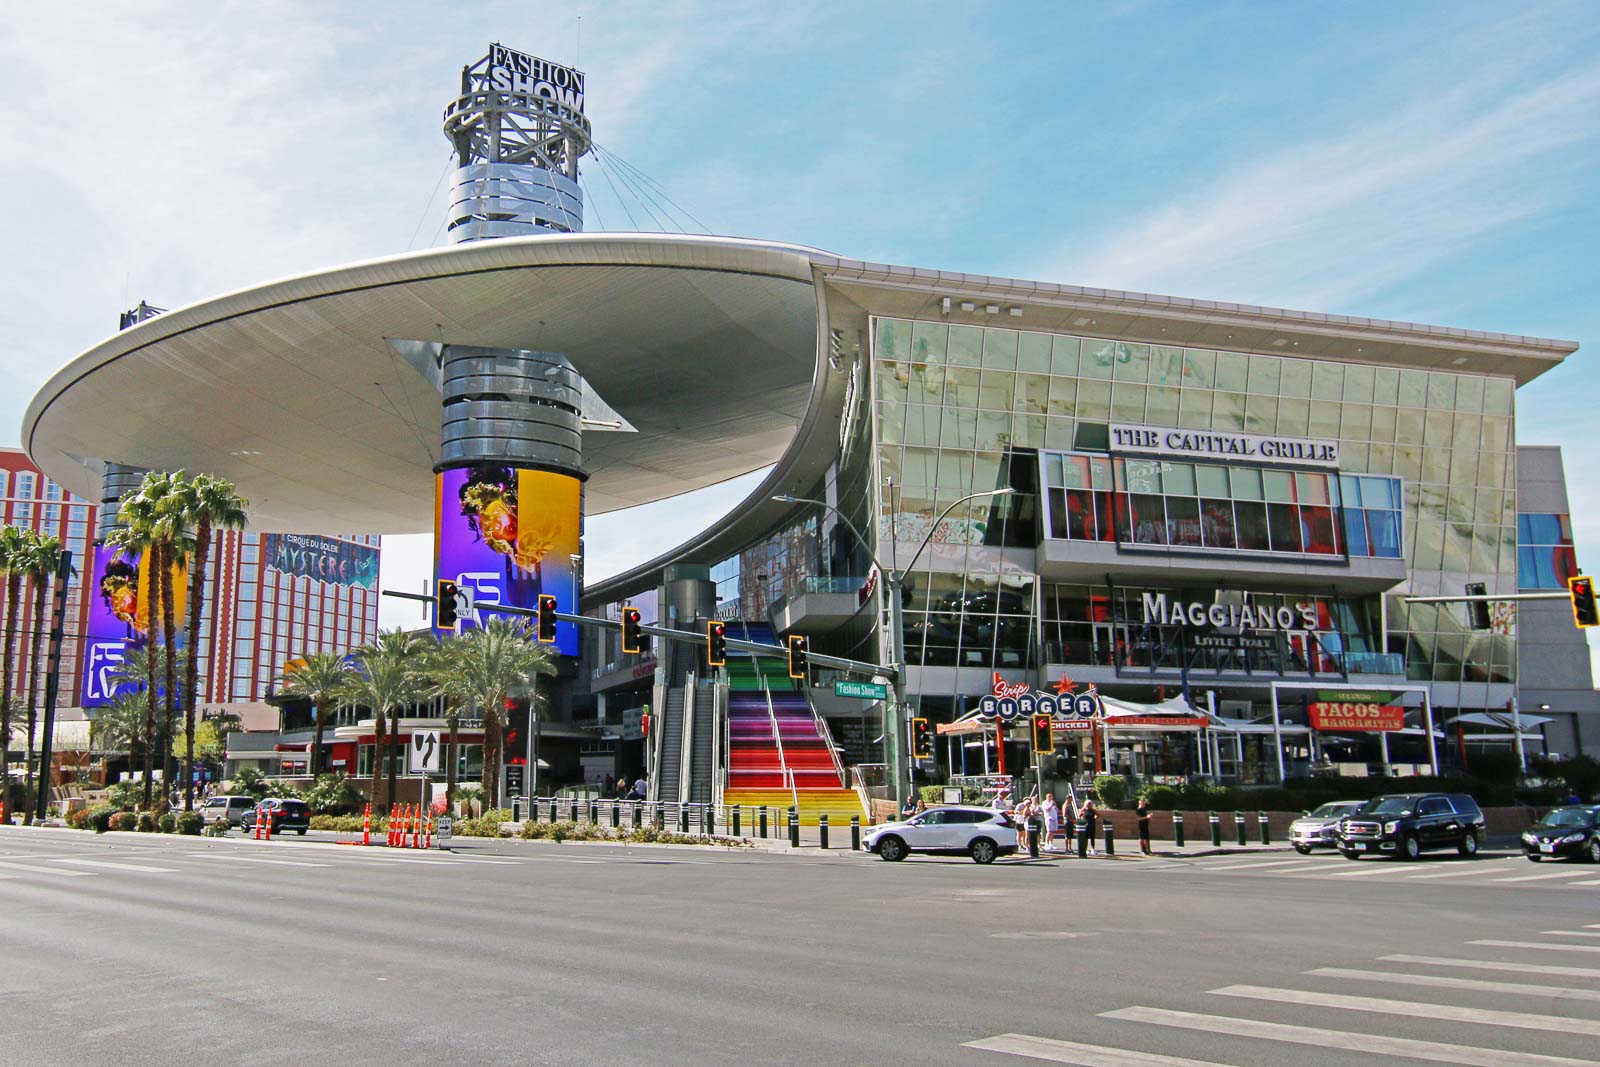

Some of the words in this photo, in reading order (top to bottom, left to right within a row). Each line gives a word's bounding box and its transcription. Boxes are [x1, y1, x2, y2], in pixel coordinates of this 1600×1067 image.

[492, 45, 583, 93] FASHION
[491, 66, 584, 111] SHOW
[1113, 428, 1159, 447] THE
[1166, 432, 1255, 456] CAPITAL
[1260, 440, 1337, 462] GRILLE
[286, 534, 310, 547] CIRQUE
[310, 539, 319, 548] DU
[320, 541, 338, 553] SOLEIL
[839, 683, 861, 696] Fashion
[861, 685, 876, 697] Show
[994, 680, 1029, 699] Strip
[983, 697, 1091, 716] BURGER
[1315, 702, 1380, 718] TACOS
[1320, 718, 1401, 729] MARGARITAS
